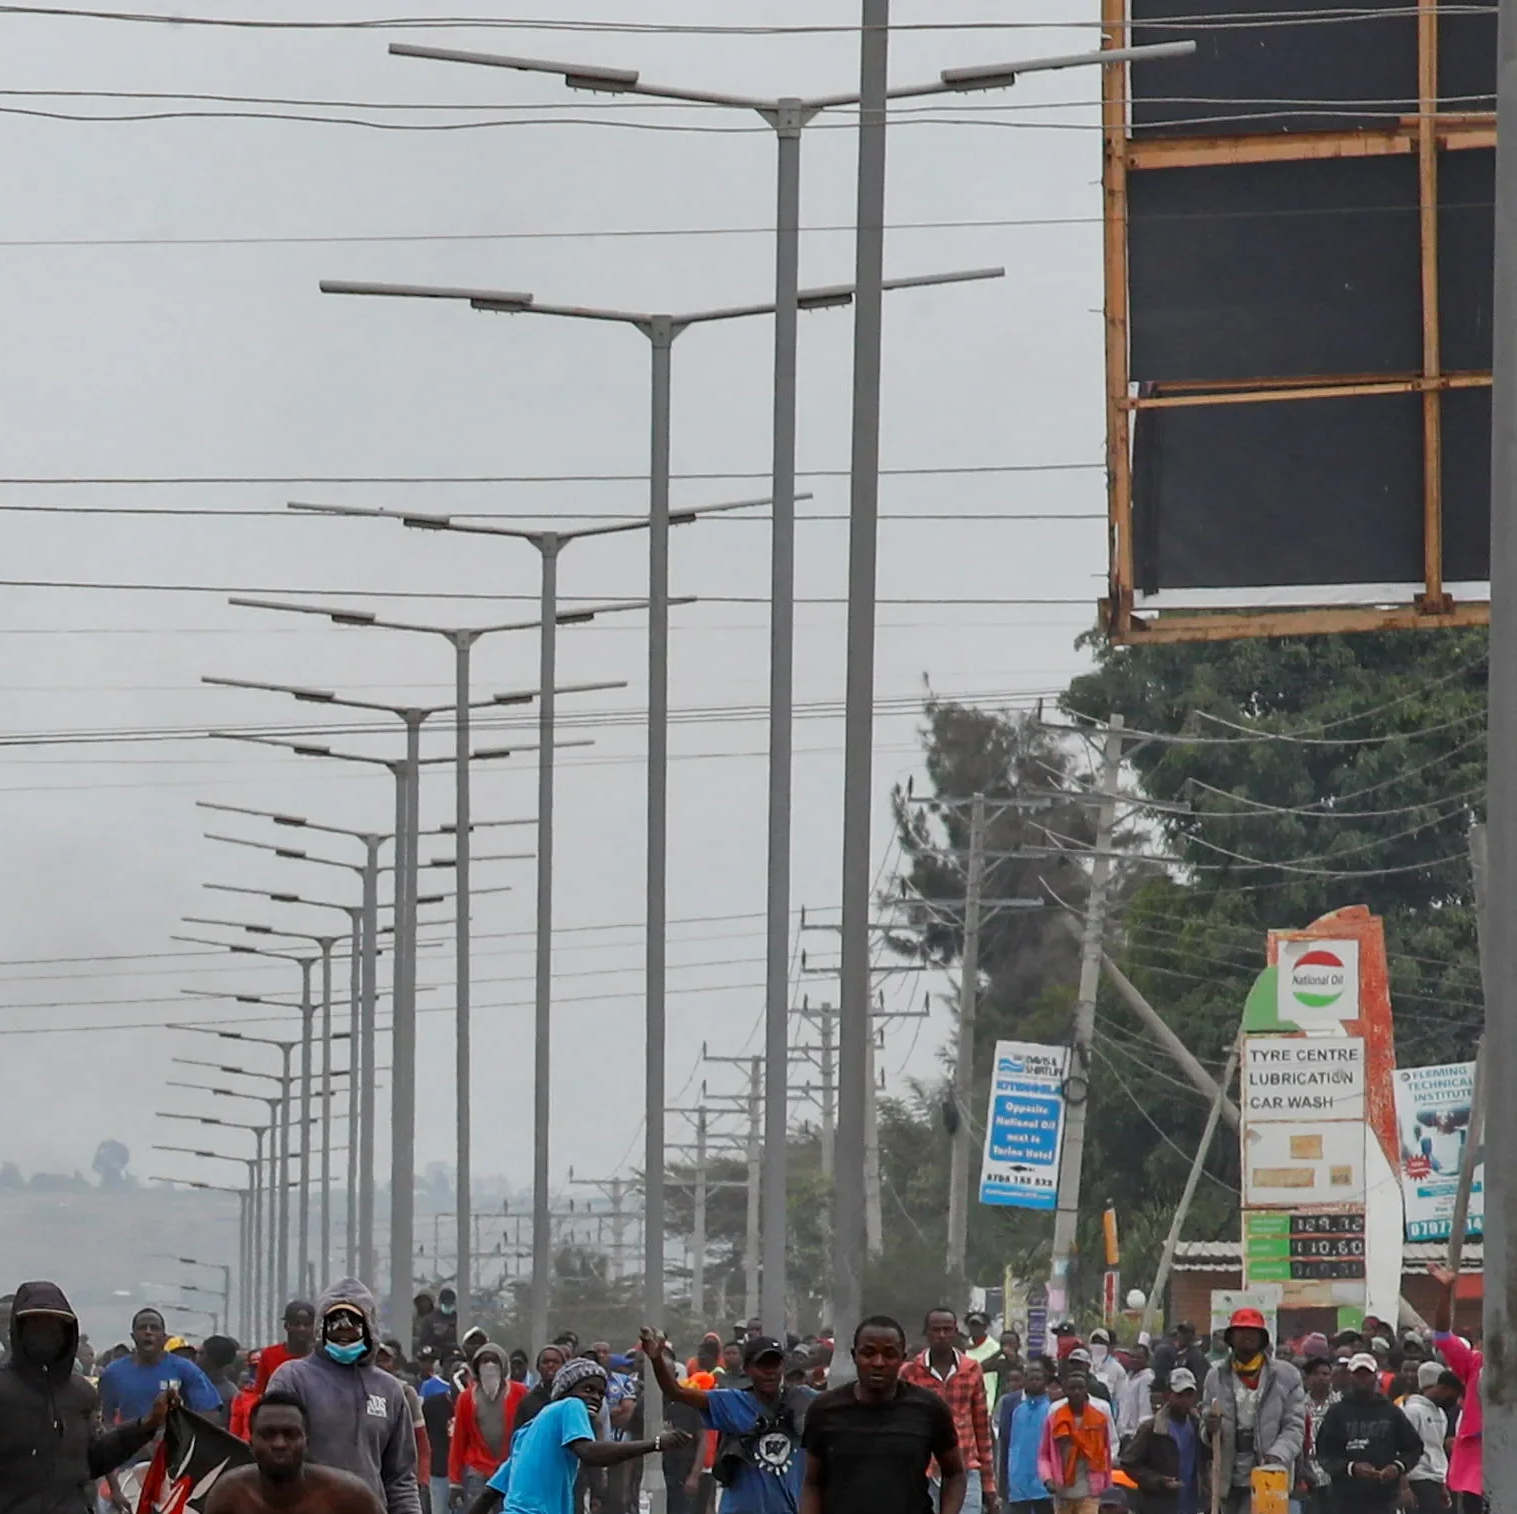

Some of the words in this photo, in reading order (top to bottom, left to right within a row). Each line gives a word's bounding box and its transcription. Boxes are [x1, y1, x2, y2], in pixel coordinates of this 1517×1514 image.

[1291, 975, 1329, 985] National
[1331, 975, 1344, 985] Oil
[1250, 1050, 1292, 1062] TYRE
[1296, 1049, 1358, 1062] CENTRE
[1249, 1072, 1353, 1086] LUBRICATION
[1250, 1097, 1283, 1110] CAR
[1288, 1096, 1334, 1110] WASH
